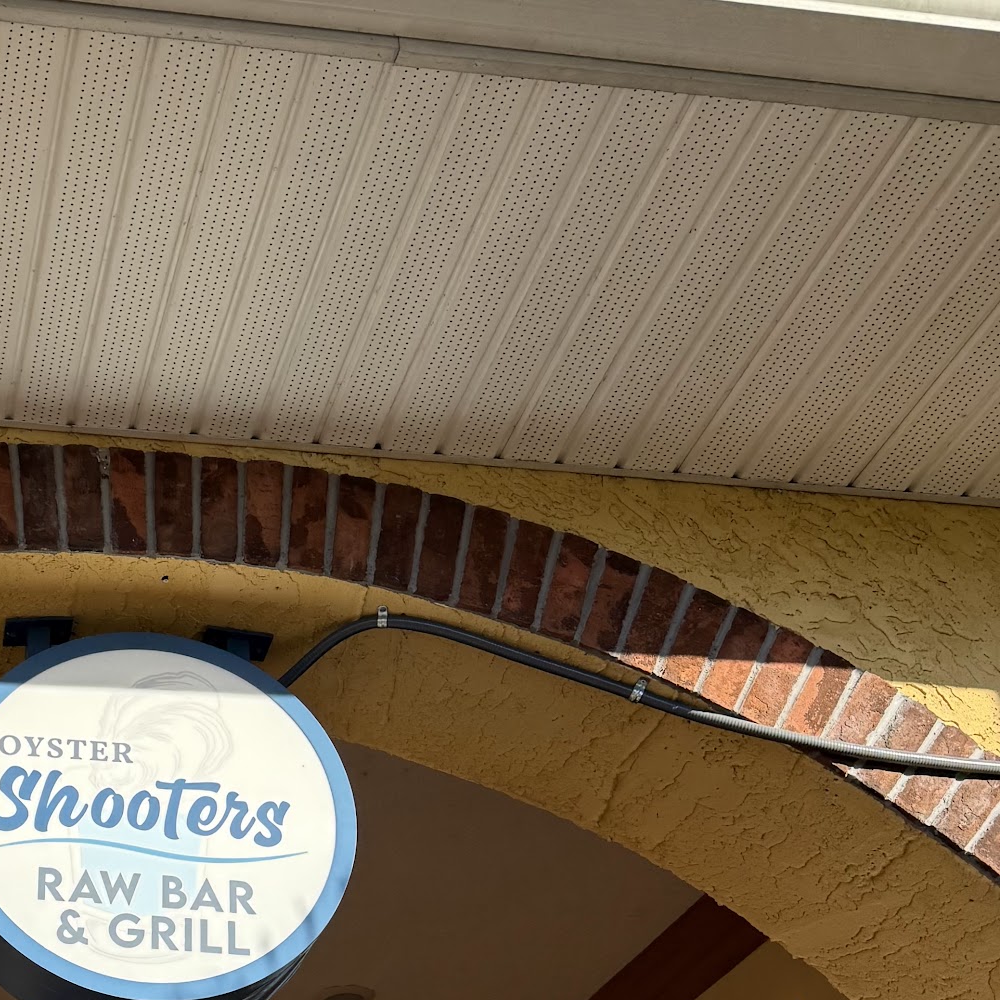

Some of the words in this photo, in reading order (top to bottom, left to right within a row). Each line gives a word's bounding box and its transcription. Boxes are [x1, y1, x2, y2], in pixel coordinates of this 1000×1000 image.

[37, 867, 141, 905] RAW
[161, 876, 256, 914] BAR
[56, 909, 88, 945] &
[108, 914, 251, 956] GRILL
